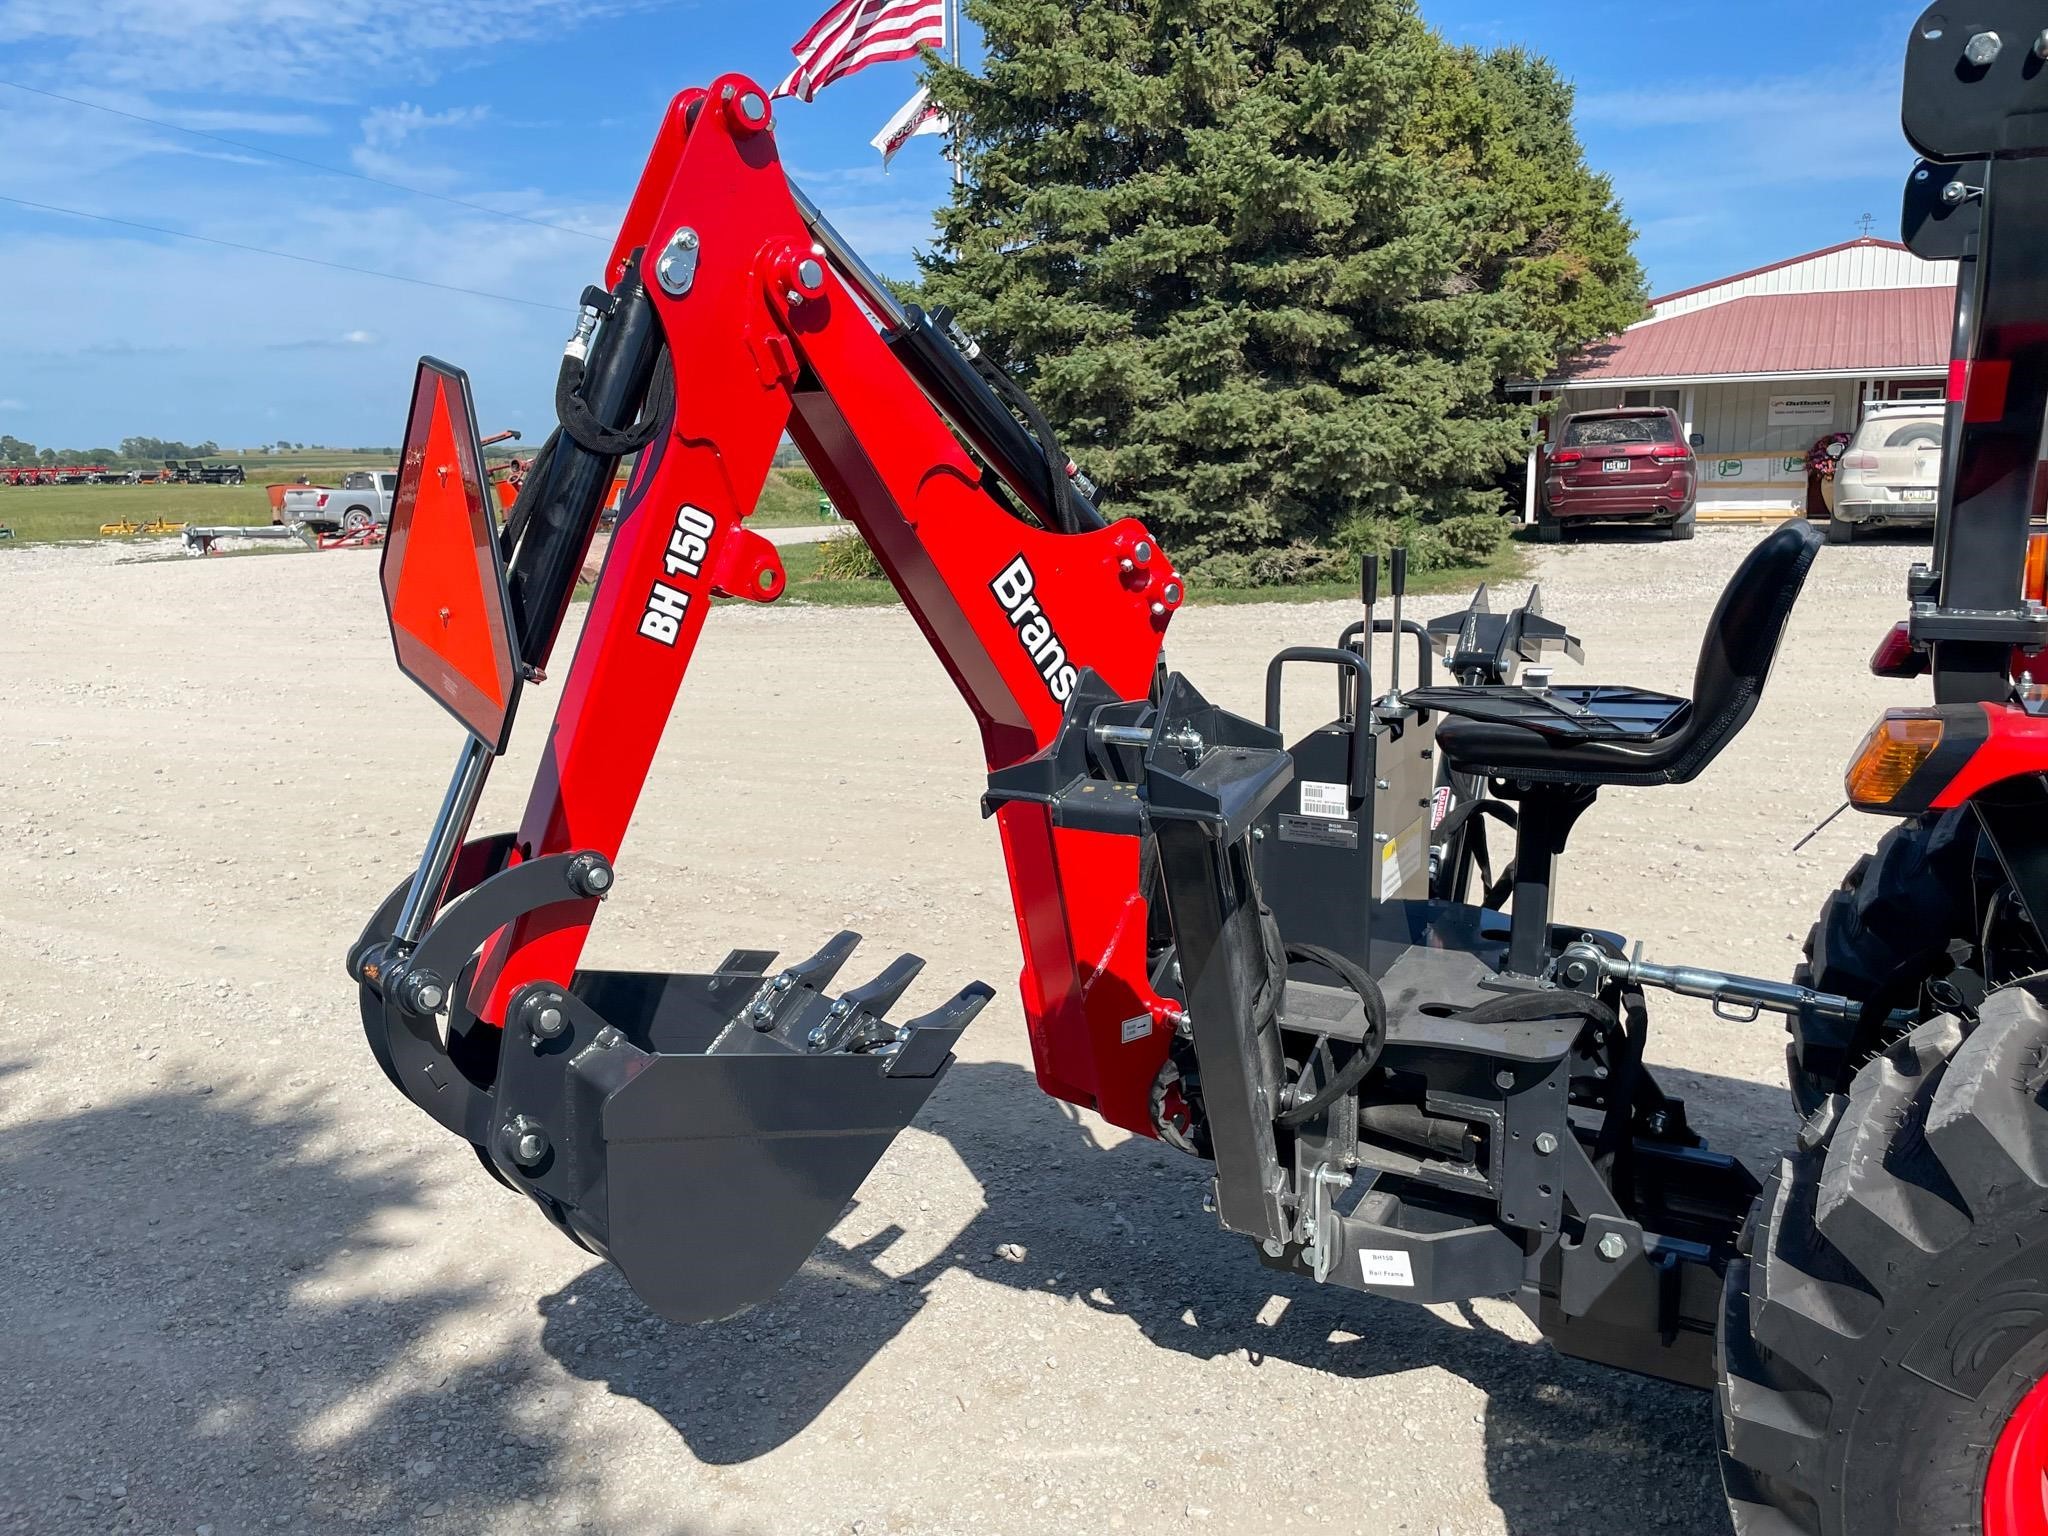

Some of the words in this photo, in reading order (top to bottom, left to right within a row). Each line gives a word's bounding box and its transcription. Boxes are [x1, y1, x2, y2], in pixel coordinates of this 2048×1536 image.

[639, 581, 690, 646] BH
[665, 504, 716, 578] 150
[990, 553, 1078, 713] Brans
